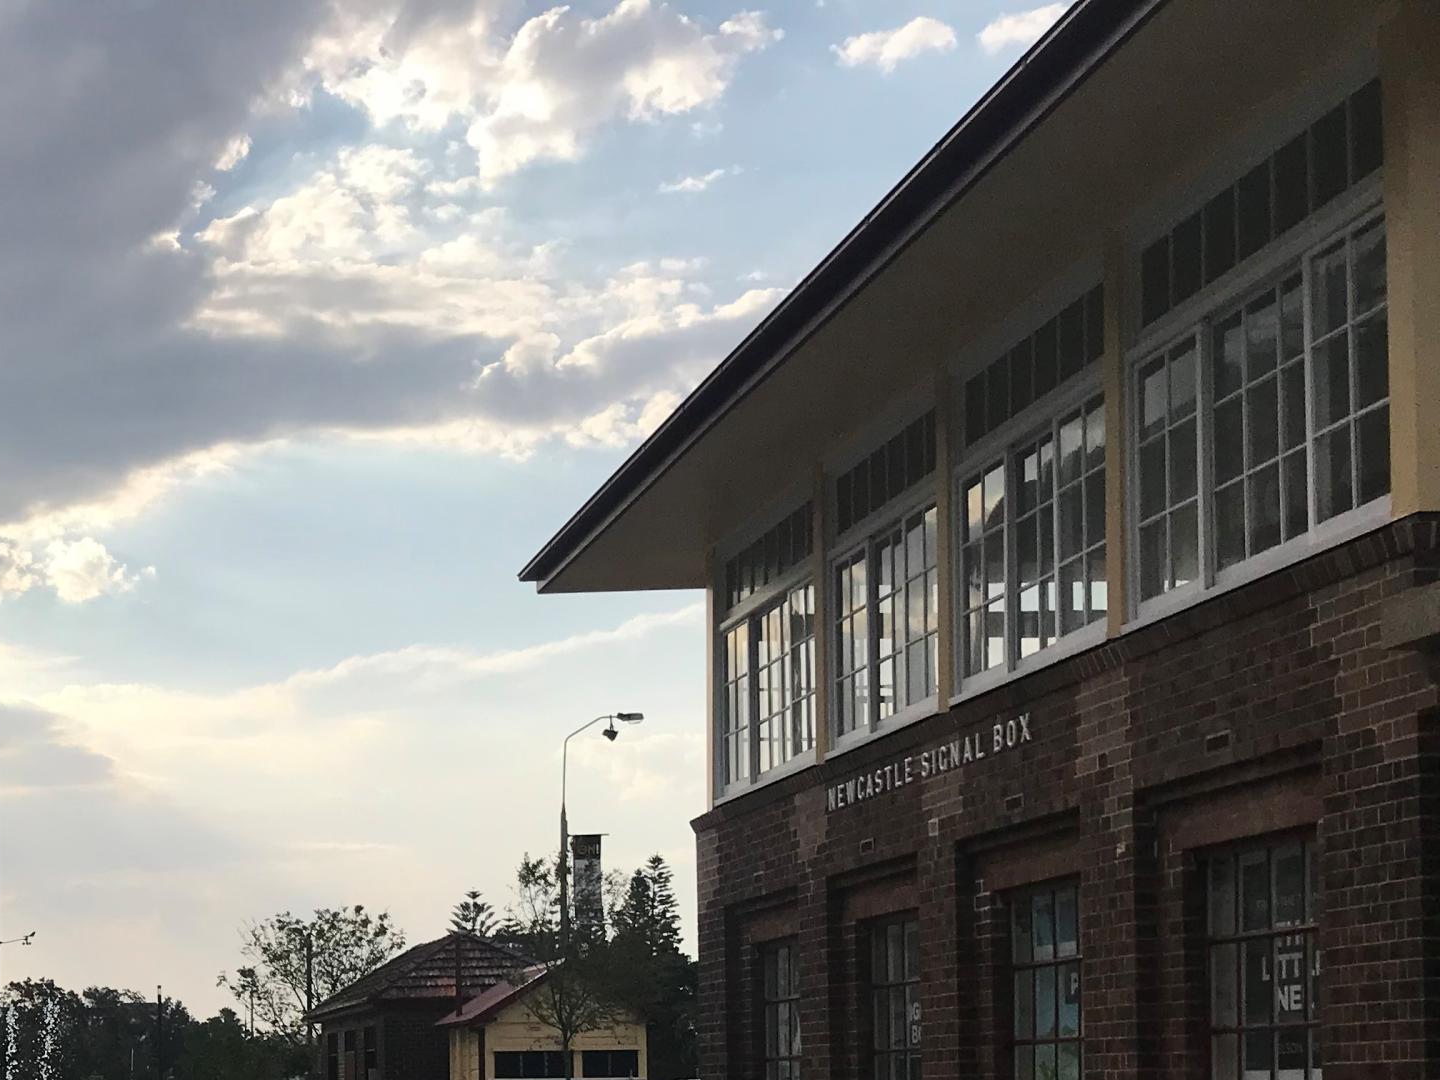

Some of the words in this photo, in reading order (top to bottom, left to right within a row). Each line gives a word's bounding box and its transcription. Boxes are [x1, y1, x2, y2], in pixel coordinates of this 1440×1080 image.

[829, 757, 913, 811] NEWCASTLE
[921, 733, 985, 777] SIGNAL
[993, 712, 1032, 751] BOX
